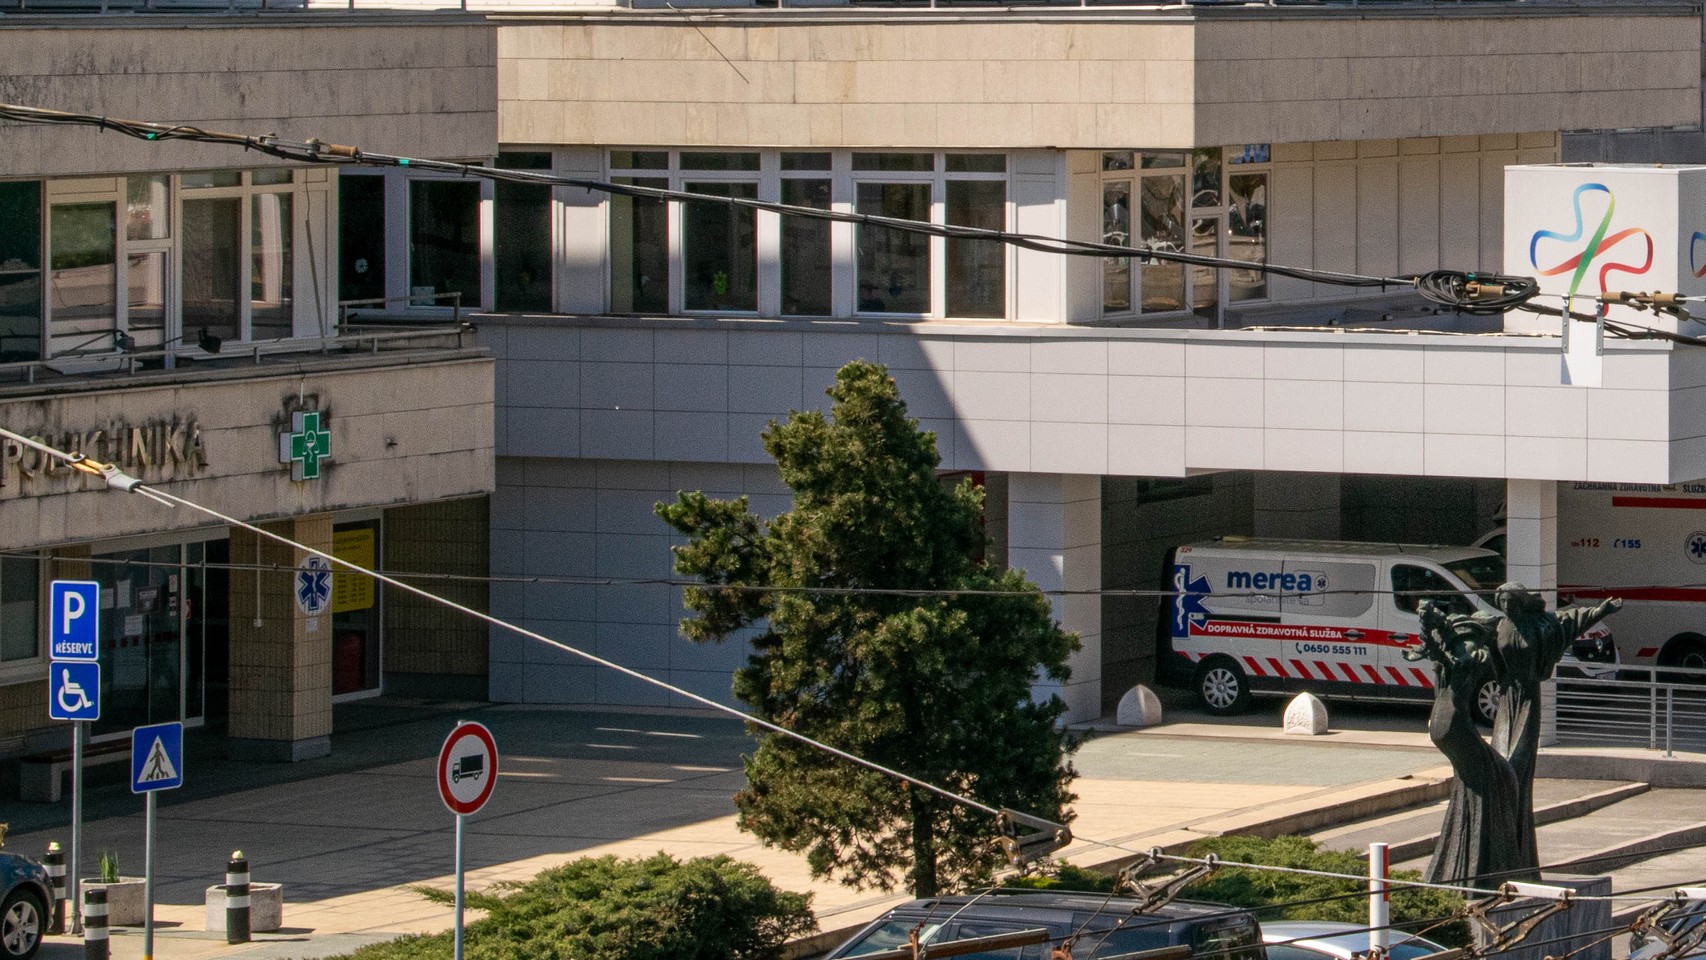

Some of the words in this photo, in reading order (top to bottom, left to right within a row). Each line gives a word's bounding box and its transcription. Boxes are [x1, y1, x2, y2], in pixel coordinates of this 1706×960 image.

[1580, 538, 1600, 548] 112
[1621, 539, 1641, 549] 155
[1226, 571, 1312, 591] merea
[63, 591, 85, 635] P
[1207, 623, 1254, 635] DOPRAVNÁ
[1256, 626, 1308, 638] ZDRAVOTNÁ
[1310, 628, 1342, 639] SLUŽBA
[1303, 644, 1330, 654] 0650
[1332, 645, 1351, 655] 555
[1354, 647, 1367, 656] 111
